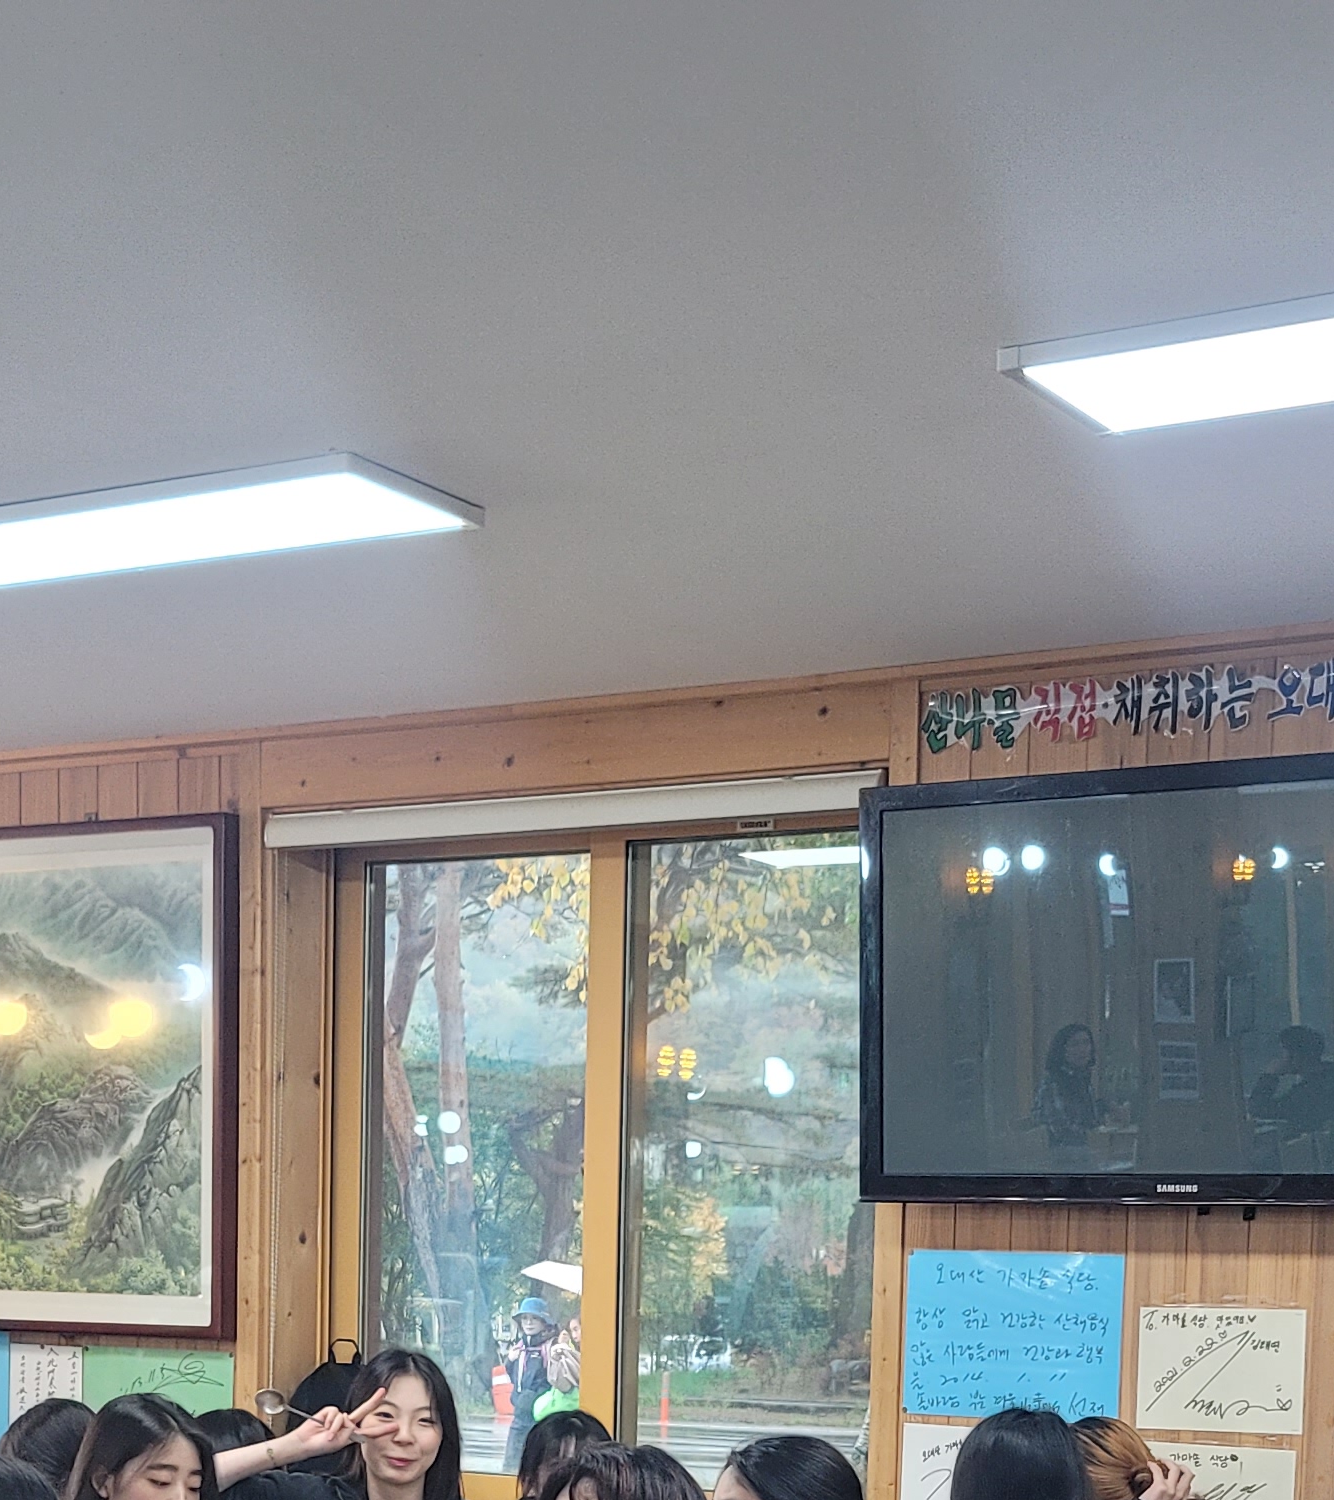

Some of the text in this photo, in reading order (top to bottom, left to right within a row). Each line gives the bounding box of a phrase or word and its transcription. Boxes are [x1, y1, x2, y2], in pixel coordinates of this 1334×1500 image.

[921, 685, 1021, 754] 산나물
[1032, 677, 1098, 742] 직접
[1112, 665, 1255, 736] 채취하는
[1156, 1183, 1198, 1193] SAMSUNG
[915, 1307, 947, 1332] 항상
[1000, 1311, 1045, 1331] 건강한
[1169, 1453, 1202, 1467] 가마솥
